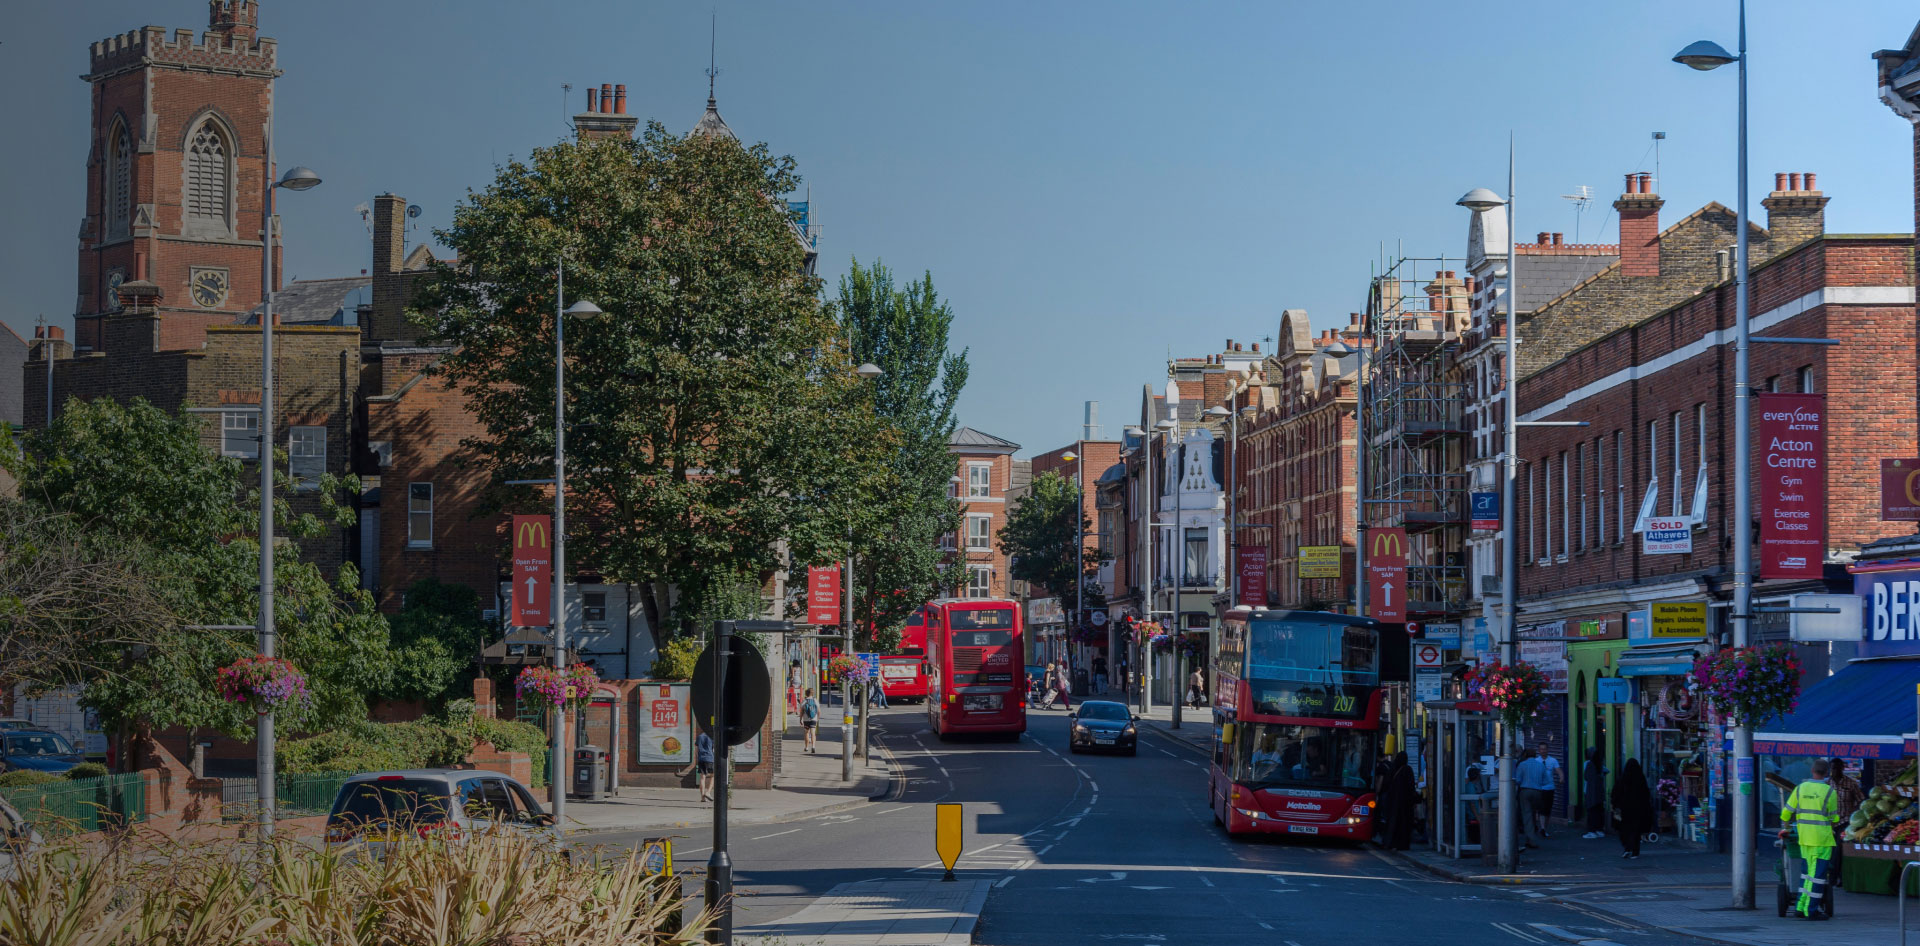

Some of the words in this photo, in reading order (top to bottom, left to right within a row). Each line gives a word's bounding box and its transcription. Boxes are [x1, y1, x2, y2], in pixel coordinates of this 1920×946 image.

[1763, 407, 1819, 423] everyone
[1769, 436, 1813, 451] Acton
[1767, 453, 1817, 468] Centre
[1780, 475, 1803, 487] Gym
[1779, 491, 1804, 502] Swim
[1774, 508, 1811, 519] Exercise
[1650, 521, 1683, 530] SOLD
[1776, 520, 1809, 531] Classes
[515, 558, 531, 566] Open
[1677, 616, 1705, 624] Unlocking
[974, 634, 988, 645] E3
[1291, 696, 1323, 706] By-Pass
[1333, 695, 1356, 712] 207
[1776, 742, 1829, 756] INTERNATIONAL
[1849, 744, 1881, 758] CENTRE
[1286, 801, 1322, 811] Metroline
